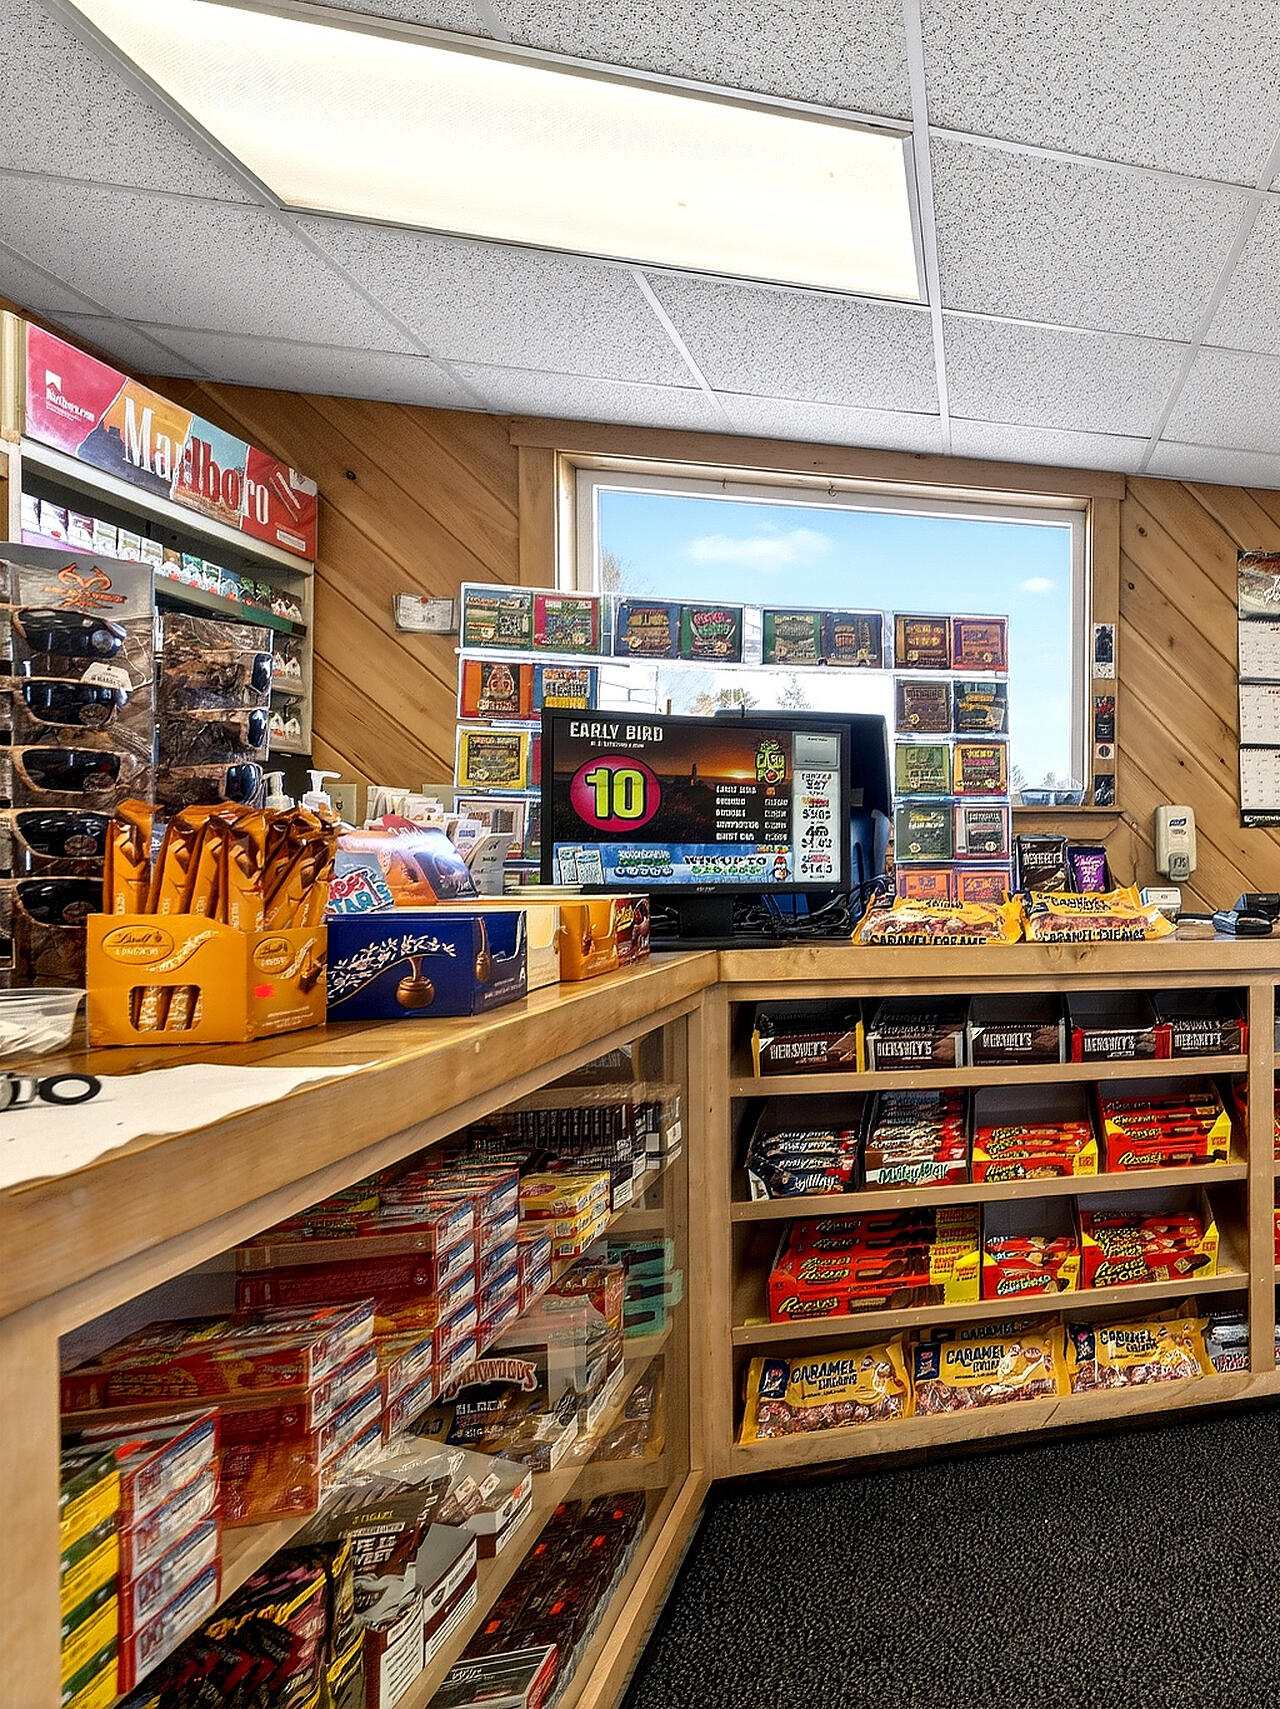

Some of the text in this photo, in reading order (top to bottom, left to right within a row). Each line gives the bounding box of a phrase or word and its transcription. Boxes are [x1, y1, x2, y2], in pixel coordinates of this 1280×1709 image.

[122, 396, 270, 525] Marlboro
[569, 721, 664, 742] EARLY BIRD
[585, 768, 646, 819] 10
[946, 1344, 1006, 1365] CARAMEL
[791, 1359, 857, 1384] CARAMEL
